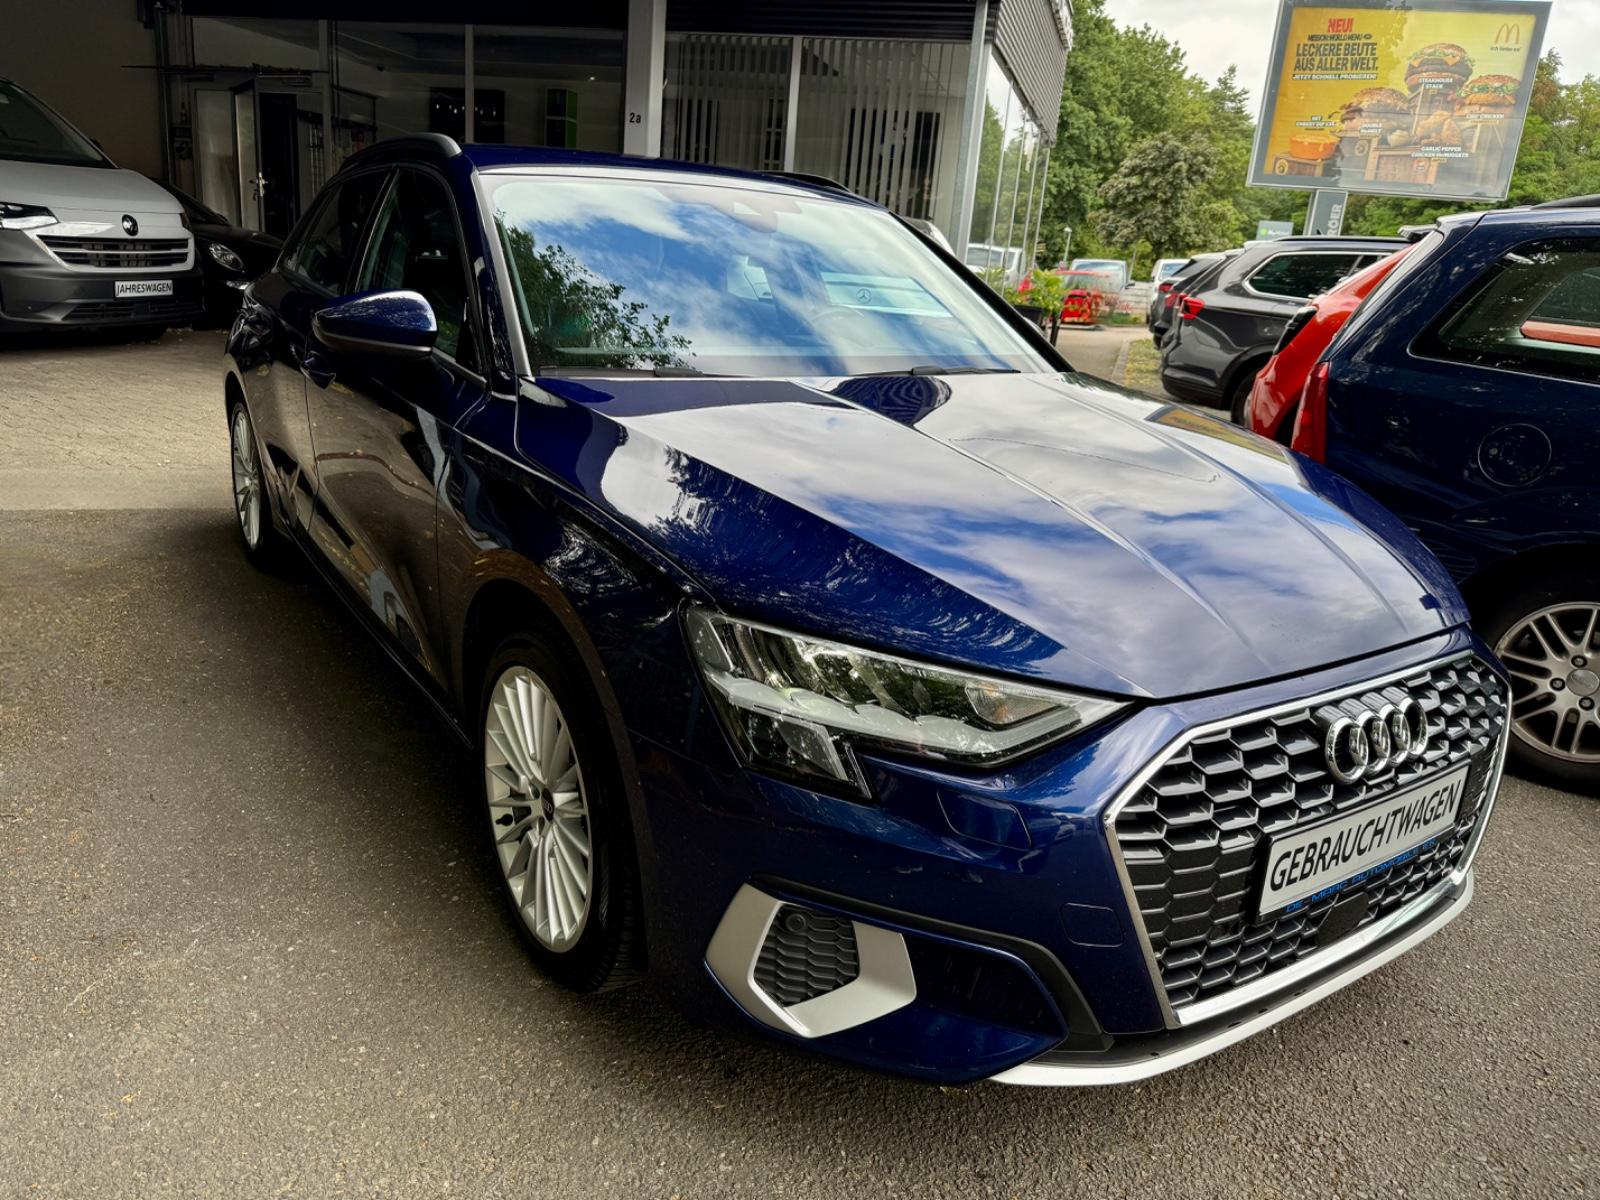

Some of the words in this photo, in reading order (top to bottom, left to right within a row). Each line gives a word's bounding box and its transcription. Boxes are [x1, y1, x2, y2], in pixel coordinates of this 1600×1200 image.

[1327, 17, 1354, 32] NEU!
[1296, 42, 1342, 57] LECKERE
[1343, 42, 1377, 57] BEUTE
[1294, 57, 1316, 71] AUS
[1316, 57, 1349, 71] ALLER
[1350, 57, 1379, 71] WELT.
[629, 112, 641, 124] 2a
[1326, 203, 1343, 236] RÖER
[116, 282, 172, 296] JAHRESWAGEN
[1270, 779, 1462, 892] GEBRAUCHTWAGEN
